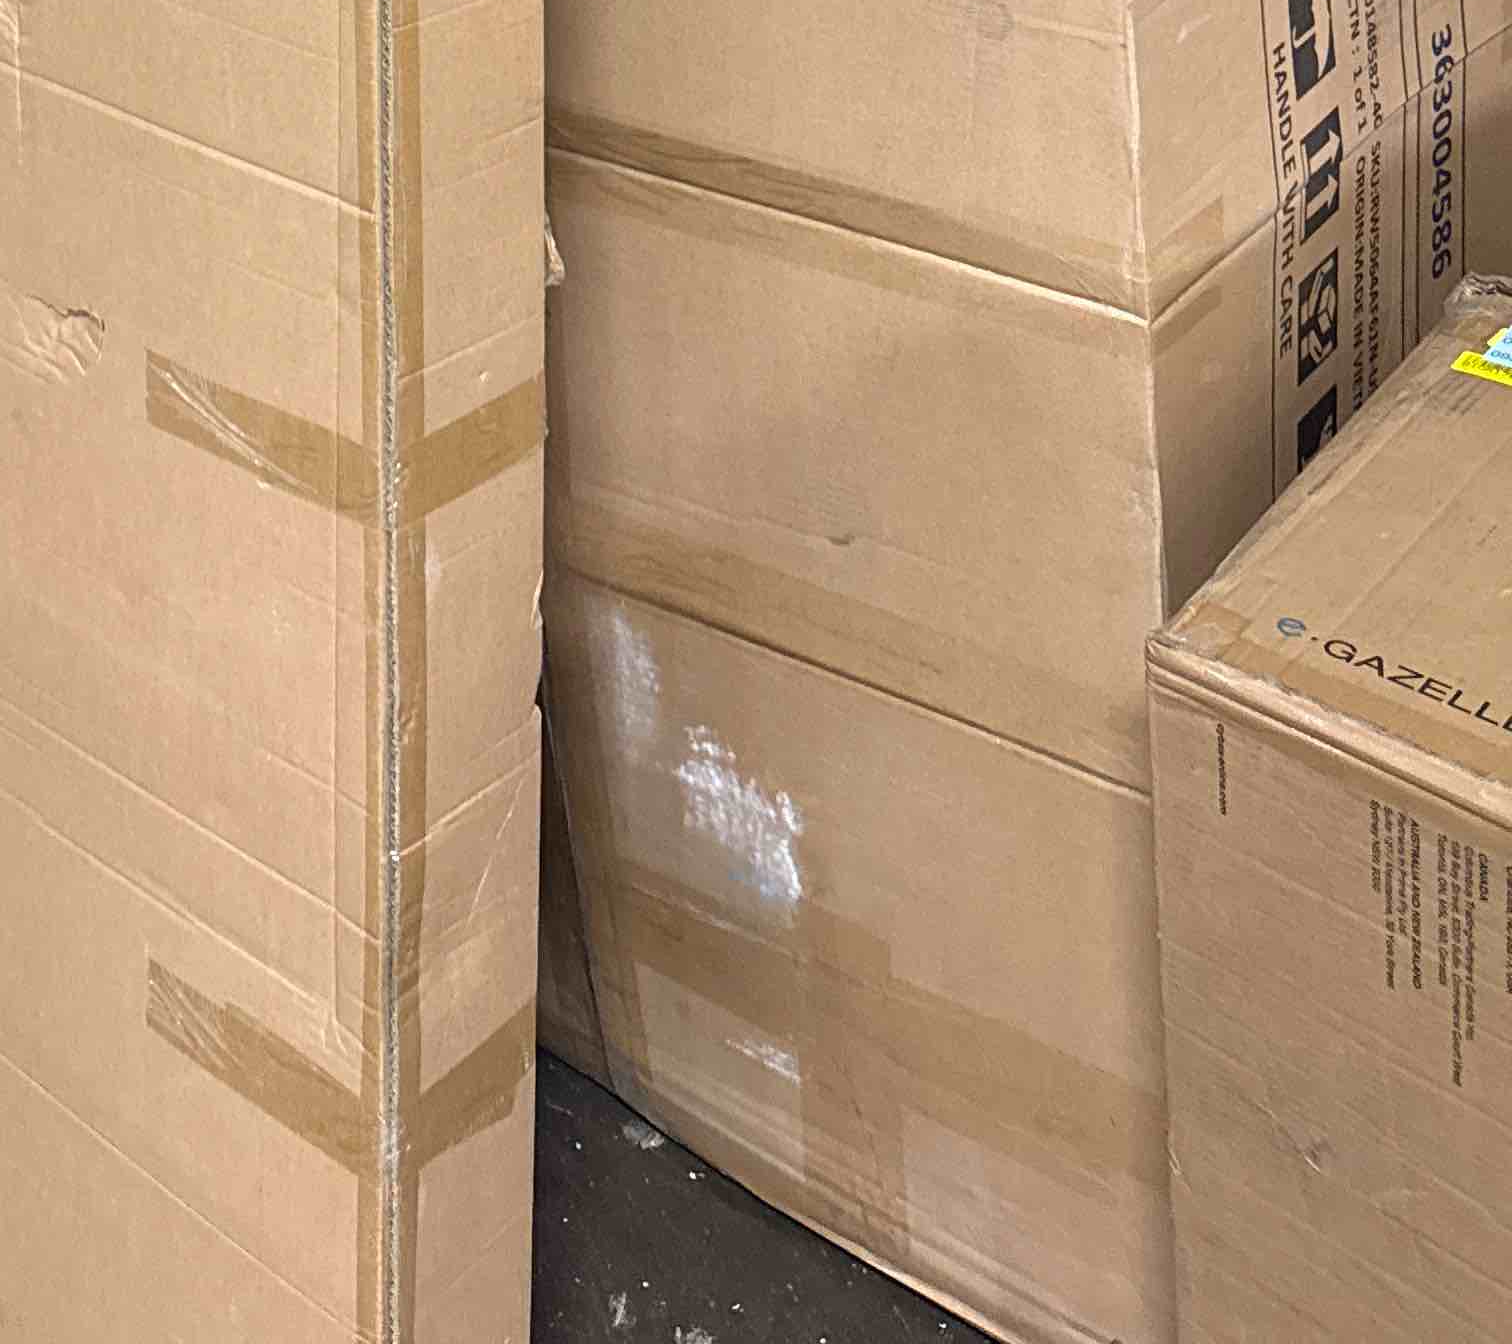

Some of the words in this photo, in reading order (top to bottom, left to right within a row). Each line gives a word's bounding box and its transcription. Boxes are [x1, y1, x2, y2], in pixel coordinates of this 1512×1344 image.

[1273, 42, 1297, 179] HANDLE
[1431, 23, 1454, 281] 363004586
[1281, 180, 1299, 268] WITH
[1279, 274, 1294, 353] CARE
